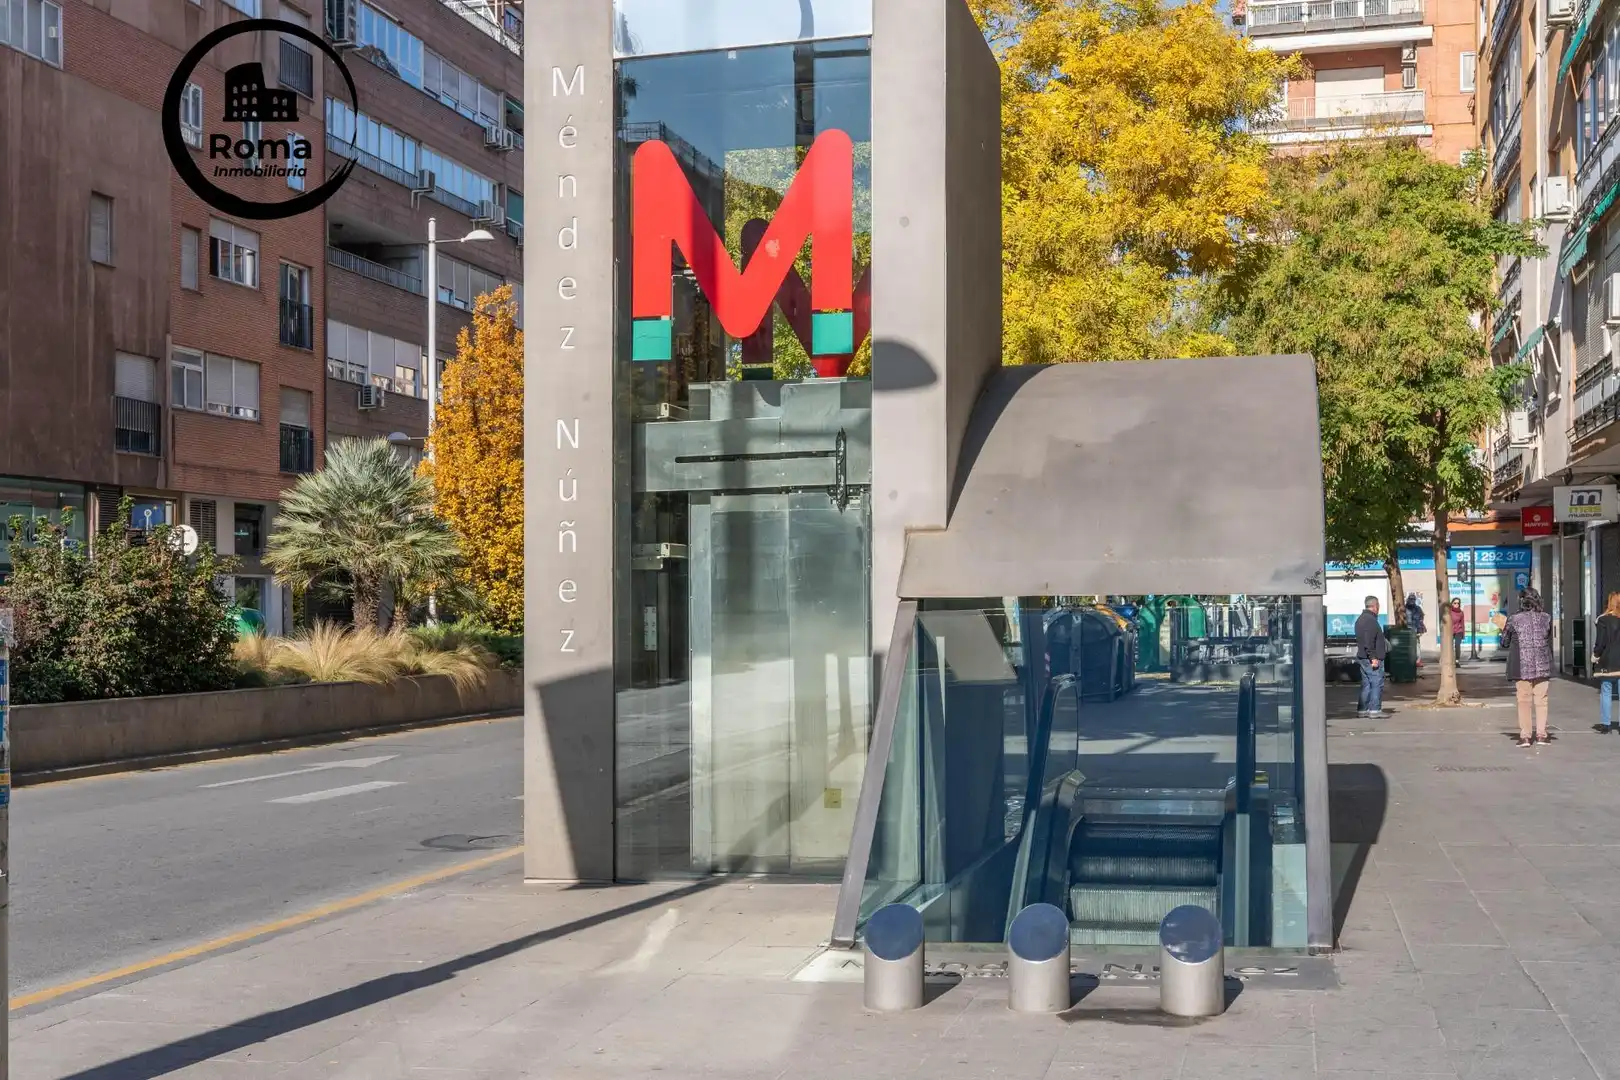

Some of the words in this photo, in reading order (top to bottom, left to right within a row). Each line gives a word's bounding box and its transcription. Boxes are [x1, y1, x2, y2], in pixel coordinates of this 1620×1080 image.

[551, 64, 585, 350] Méndez
[556, 418, 580, 653] Núñez
[1481, 551, 1503, 562] 292
[1506, 551, 1525, 561] 317
